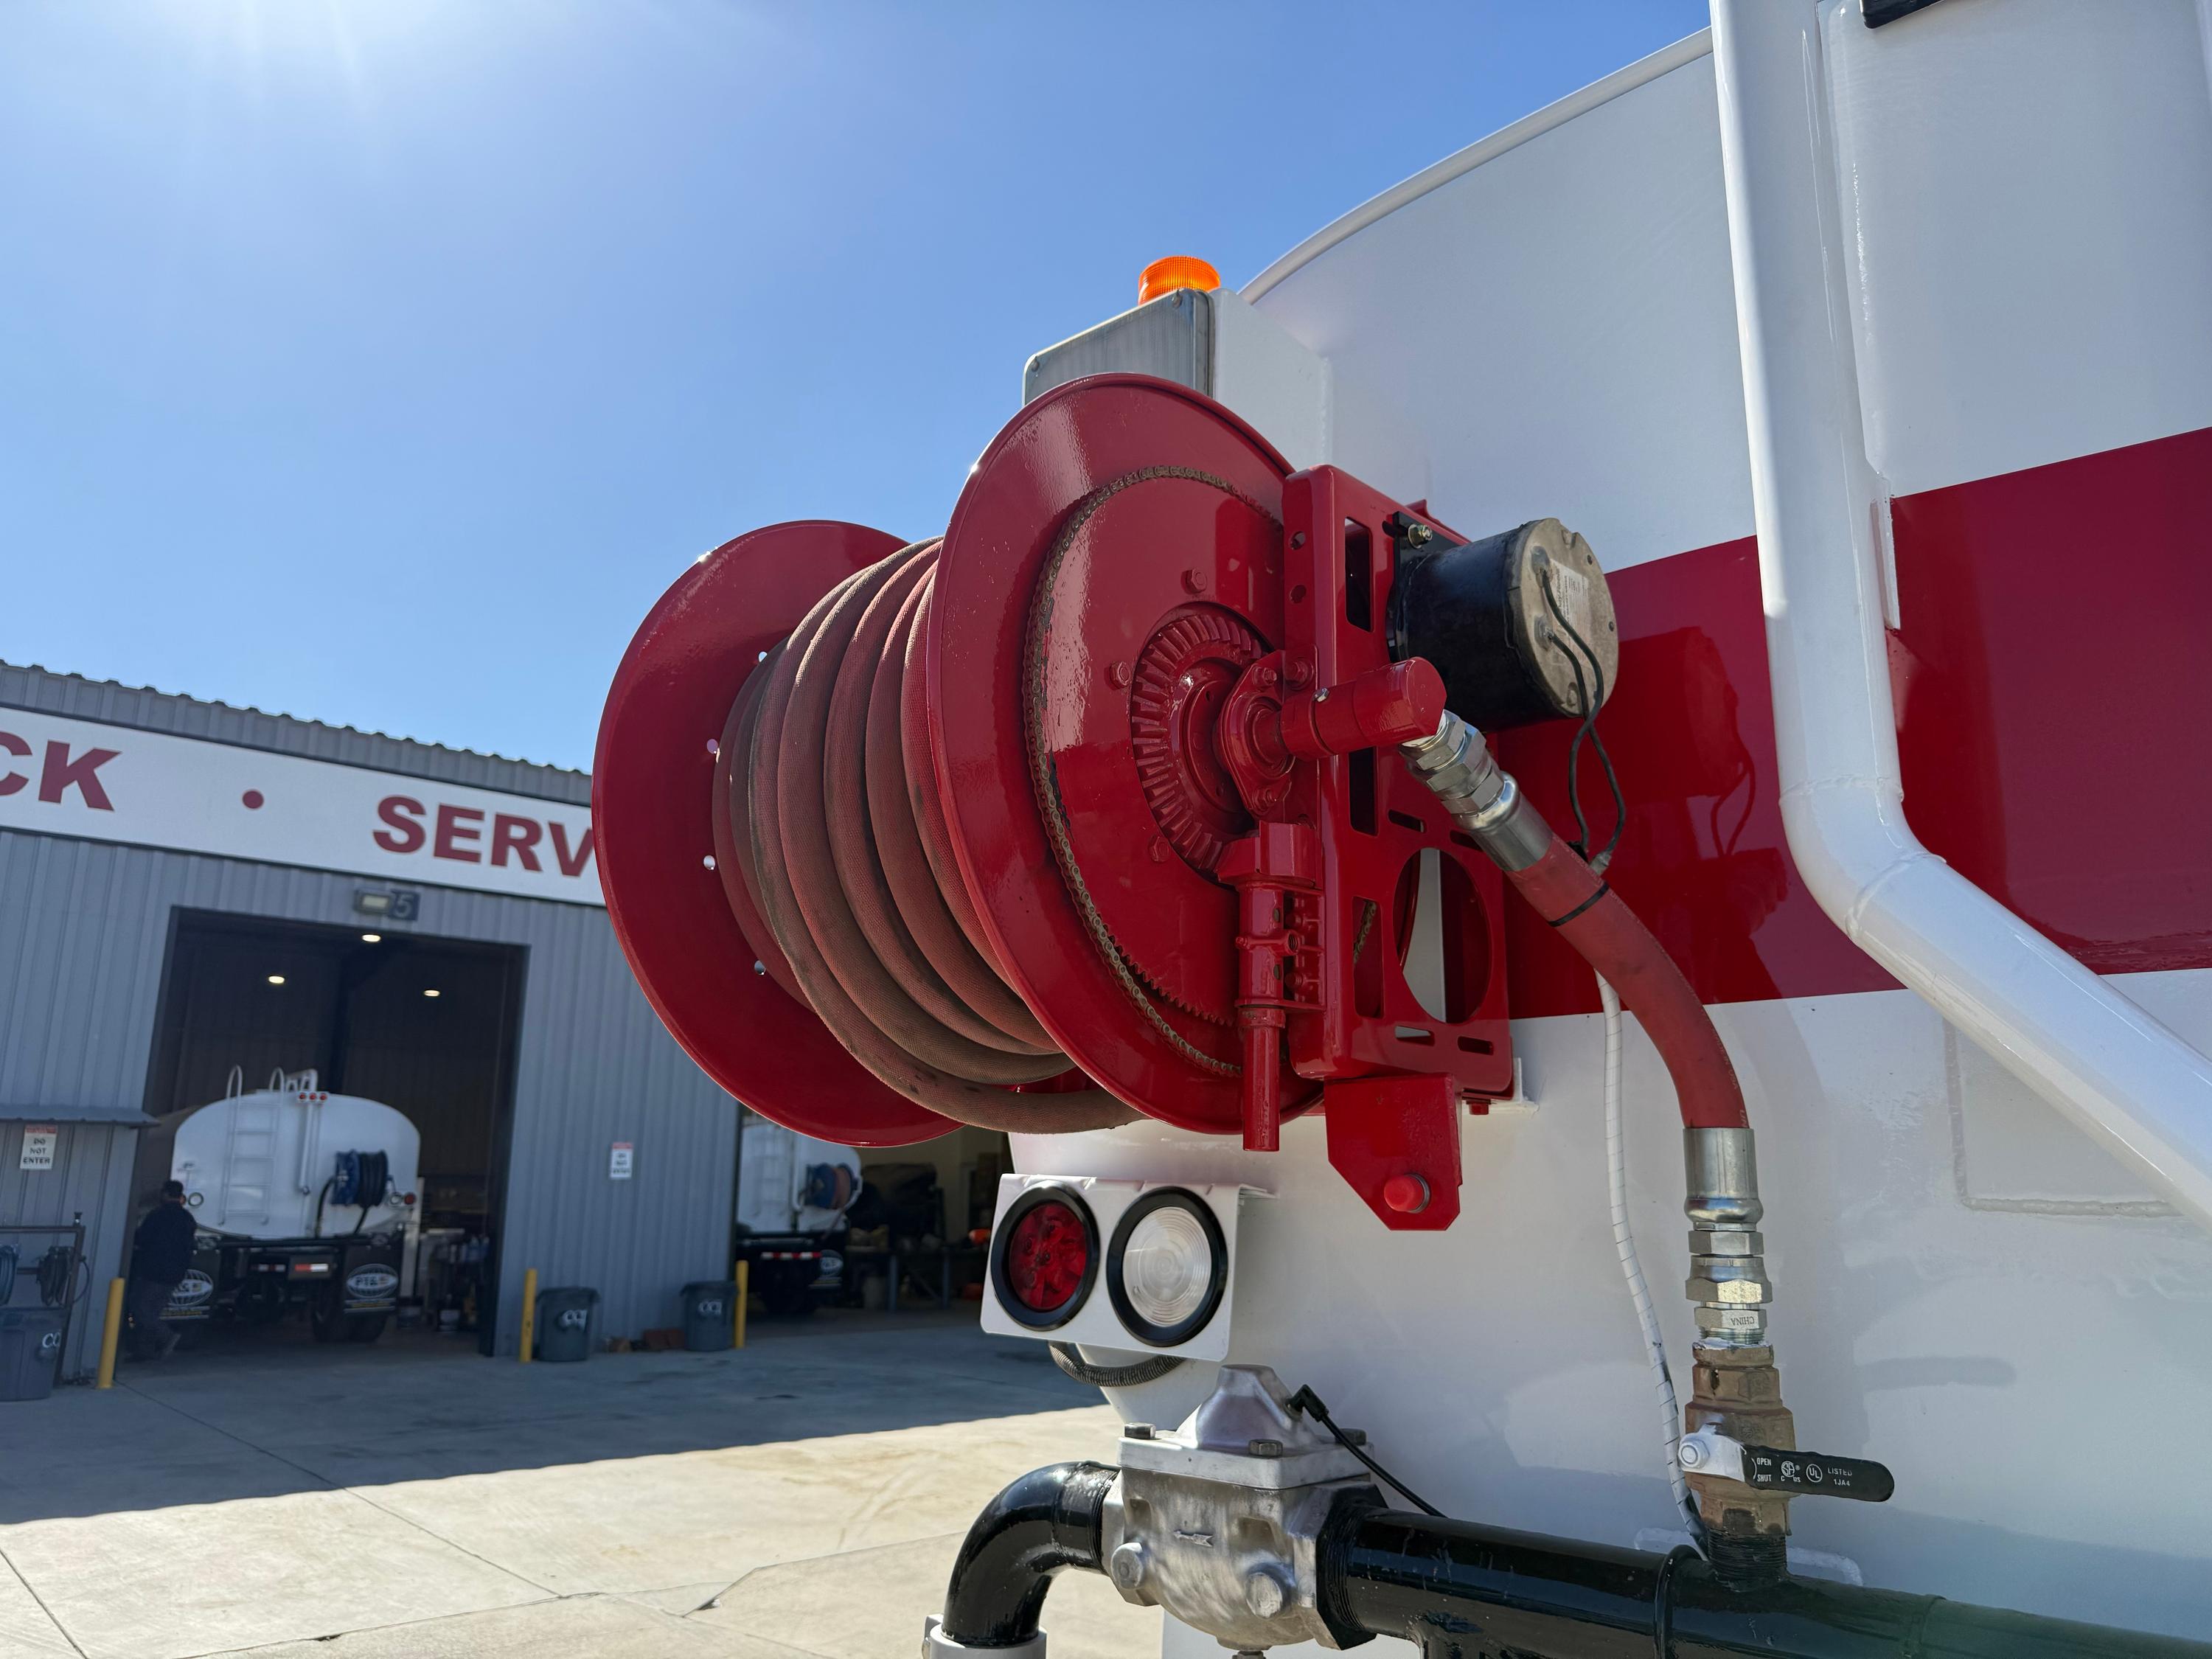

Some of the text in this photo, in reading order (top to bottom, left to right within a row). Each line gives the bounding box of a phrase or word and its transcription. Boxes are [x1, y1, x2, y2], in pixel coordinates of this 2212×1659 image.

[1731, 1316, 1755, 1326] CHINA
[1756, 1457, 1772, 1467] OPEN
[1757, 1474, 1772, 1482] SHUT
